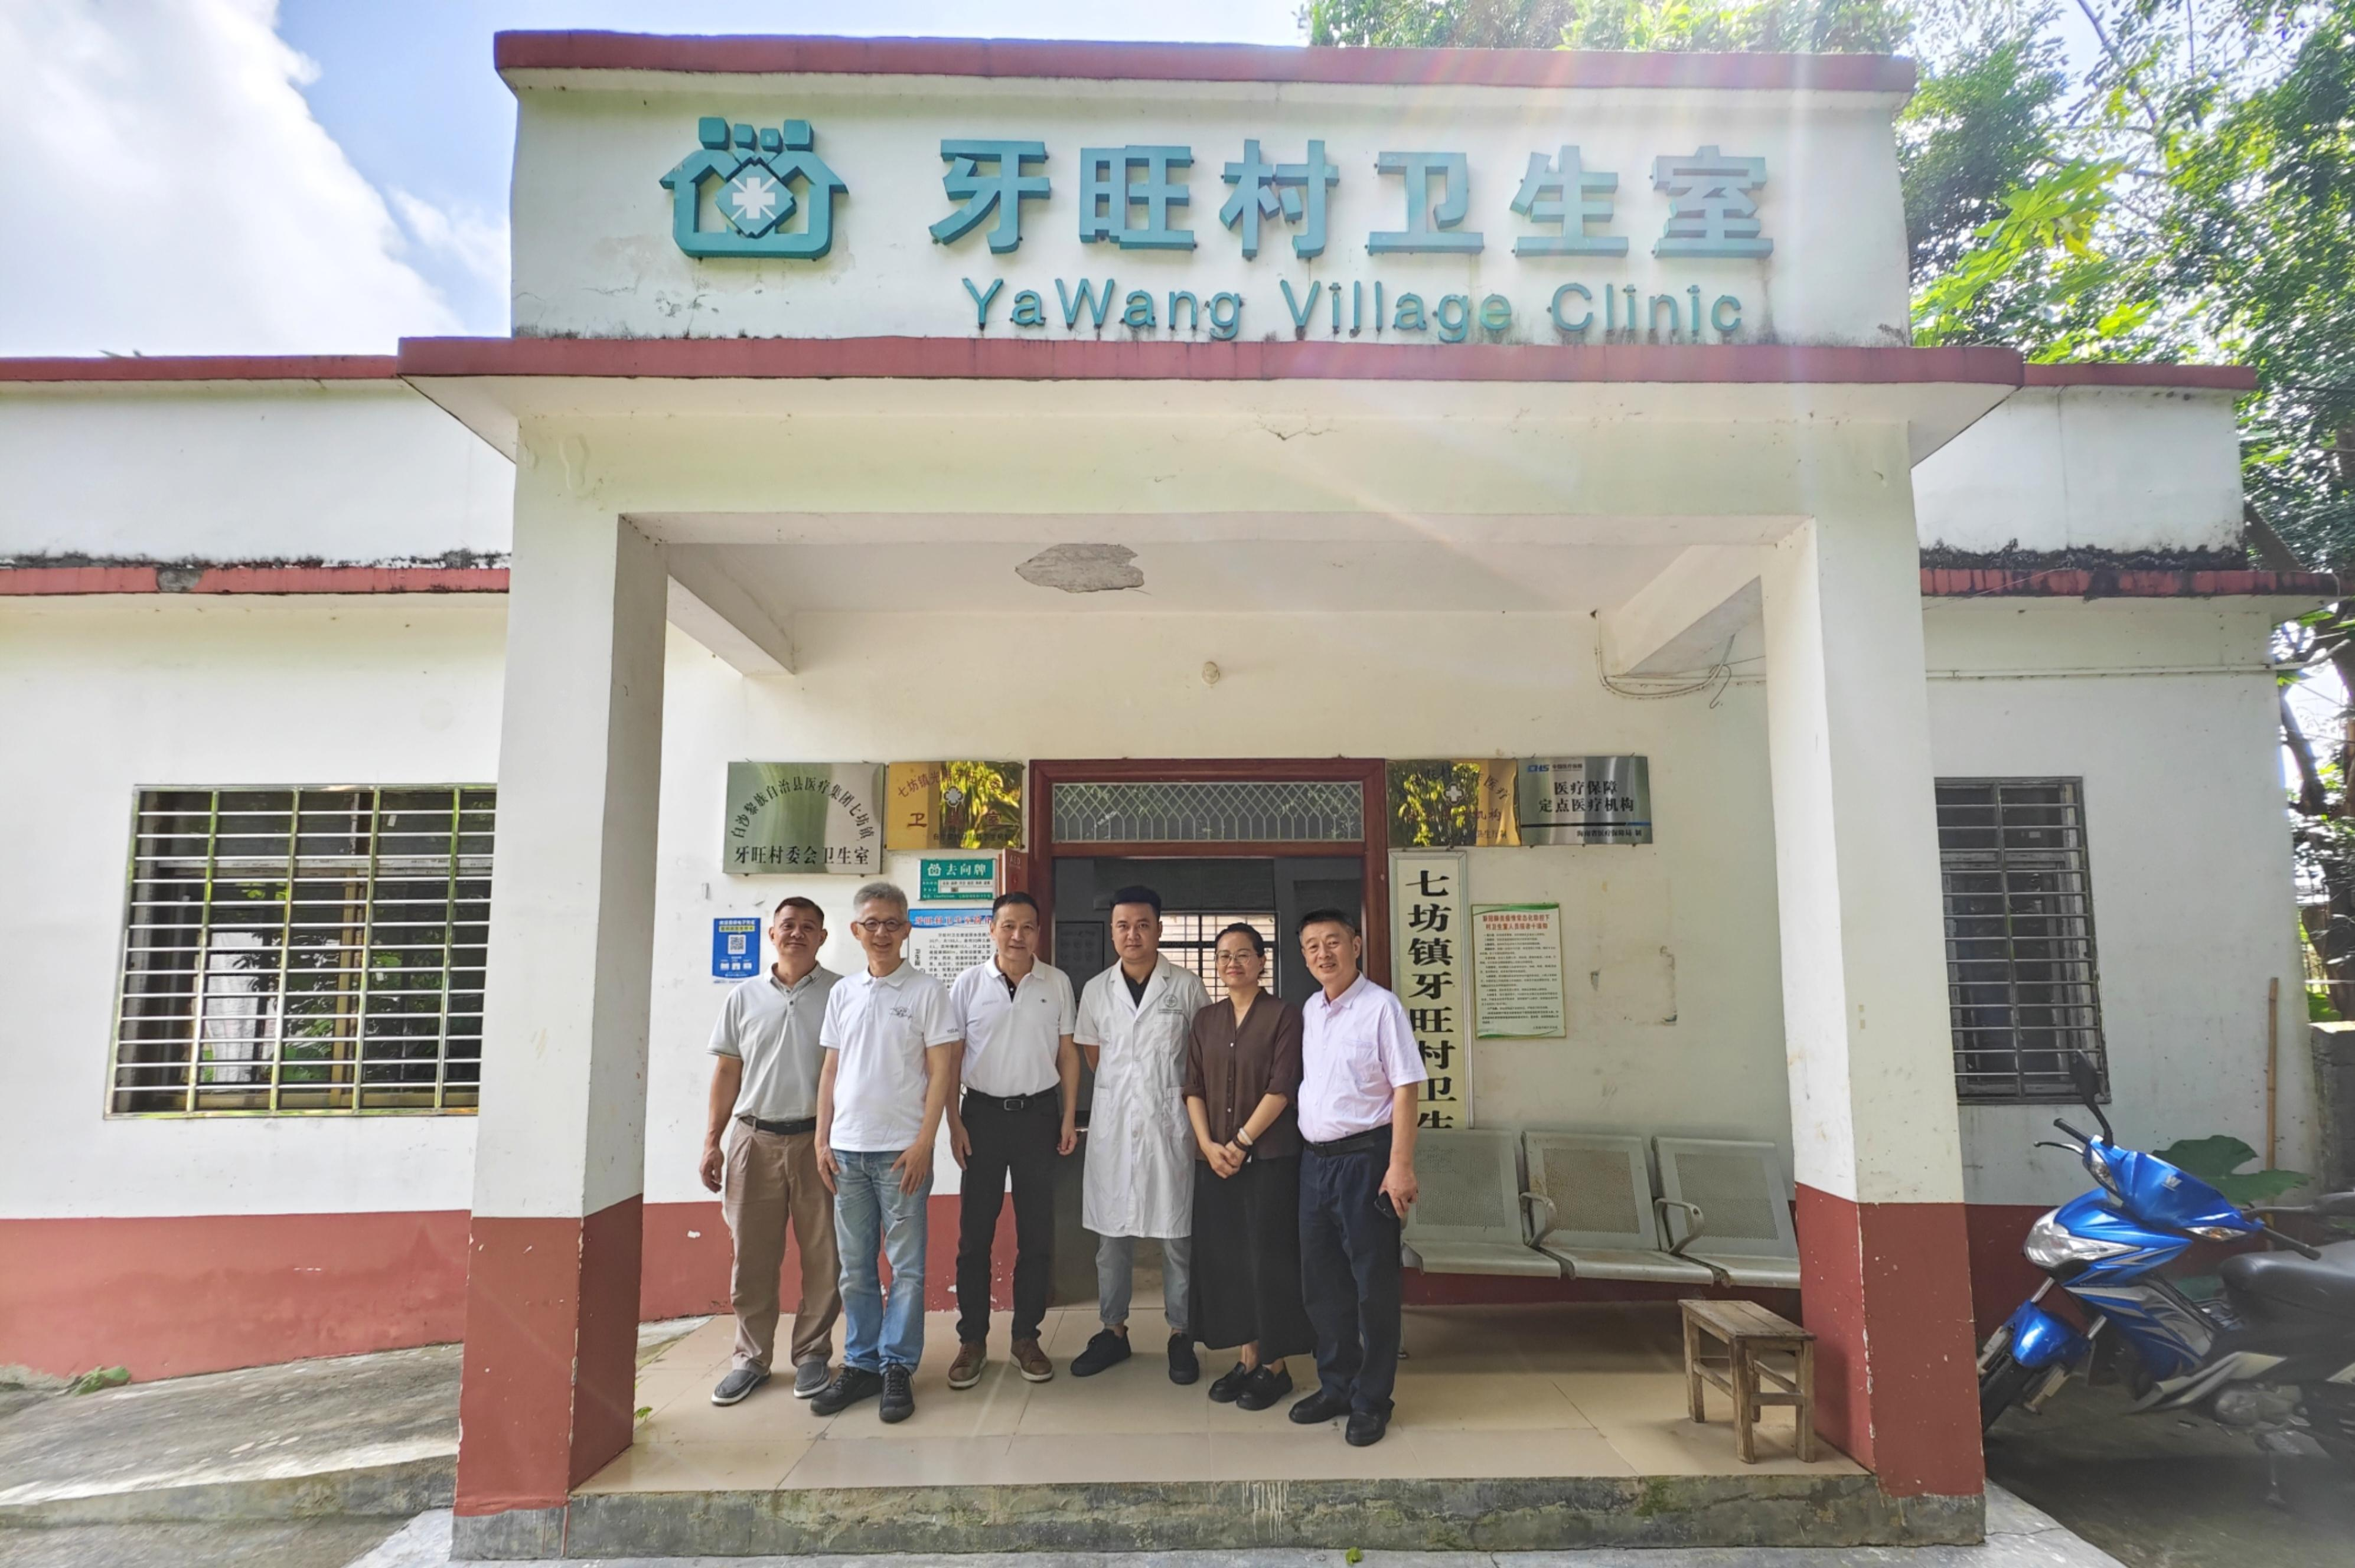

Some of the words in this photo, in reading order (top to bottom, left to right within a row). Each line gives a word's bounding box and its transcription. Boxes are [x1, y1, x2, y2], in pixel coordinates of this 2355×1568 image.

[929, 139, 1774, 259] 牙旺村卫生室
[961, 278, 1241, 341] YaWang
[1279, 280, 1512, 342] Village
[1551, 282, 1742, 334] Clinic
[1554, 780, 1618, 795] 医疗保障
[1538, 798, 1634, 813] 定点医疗机构
[734, 845, 870, 865] 牙旺村委会卫生室
